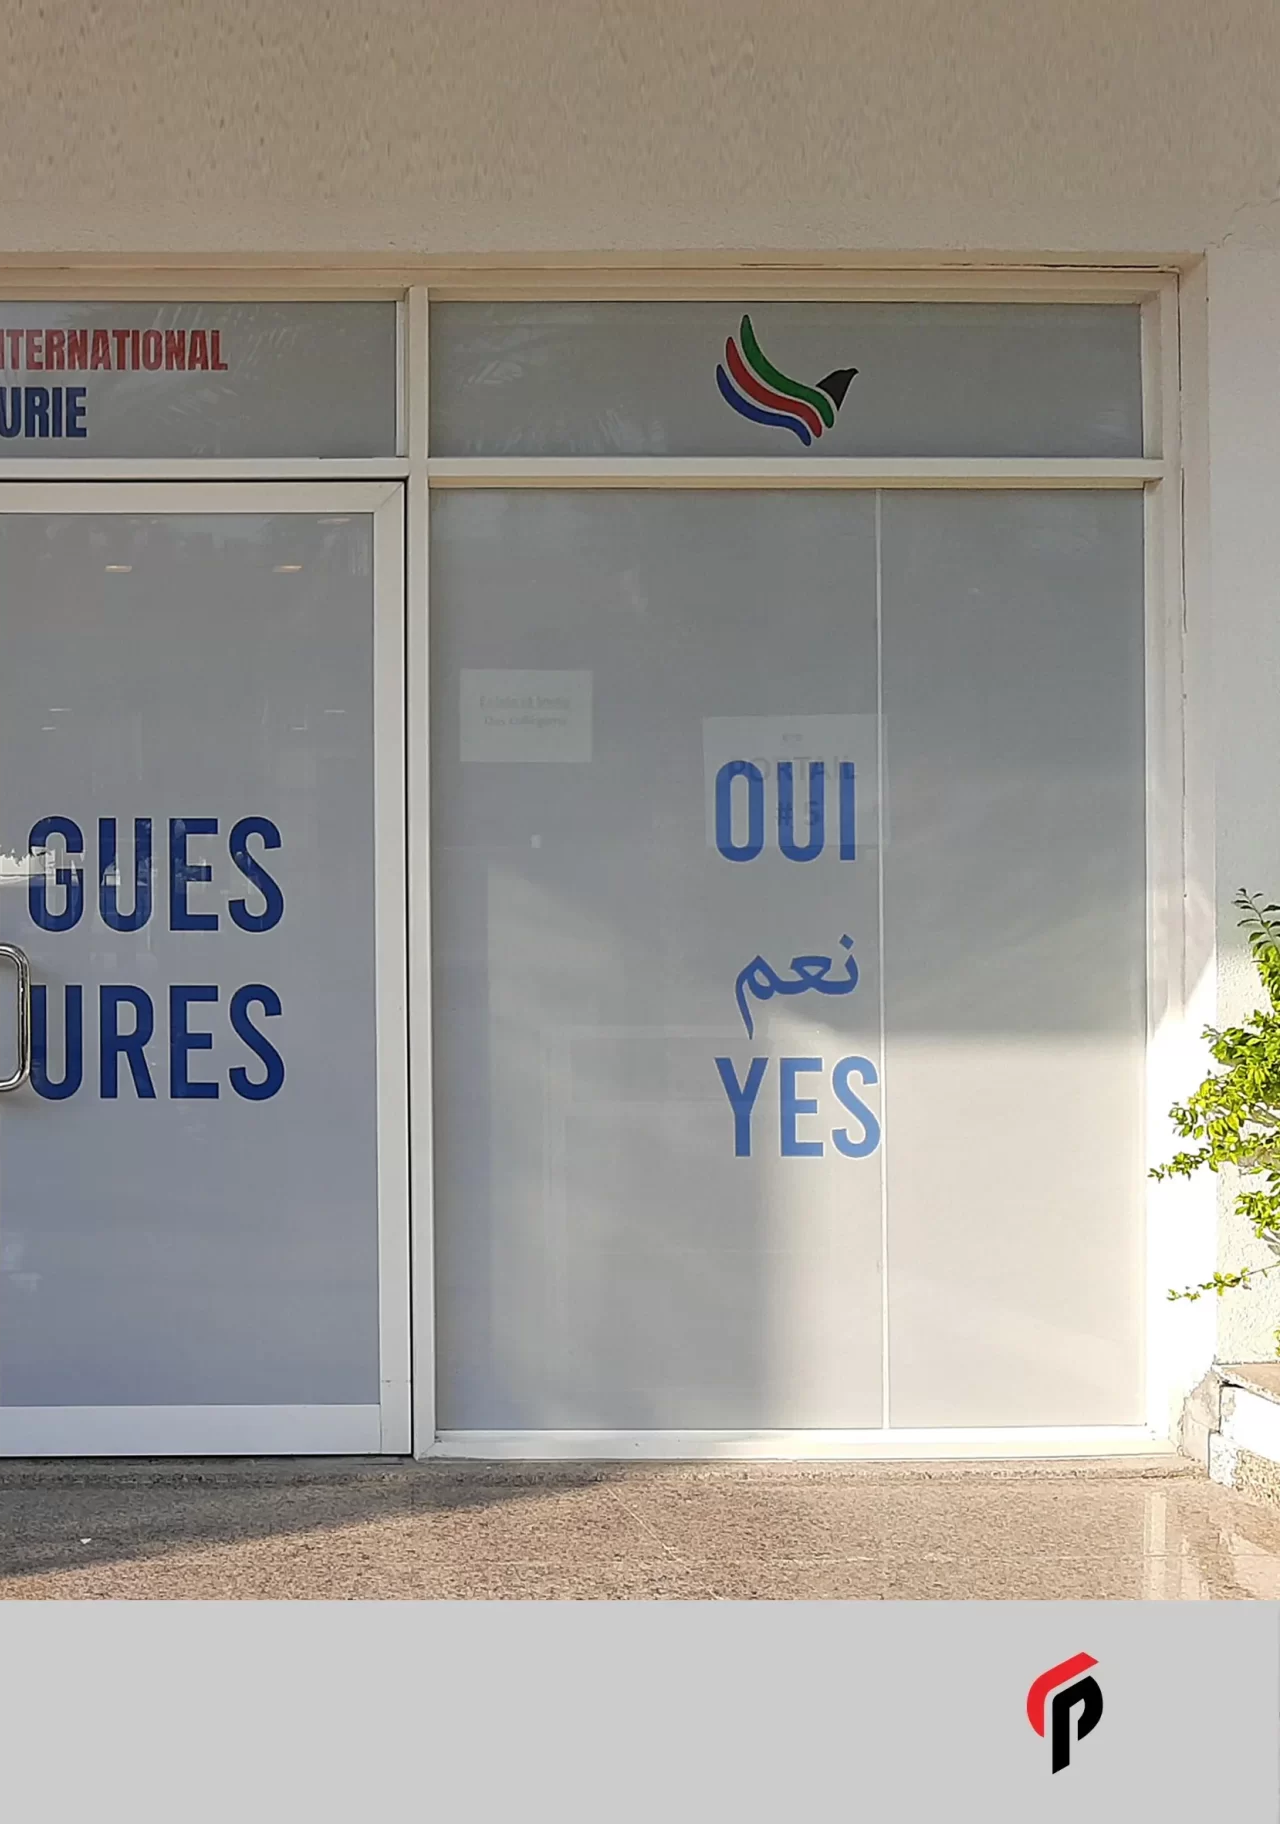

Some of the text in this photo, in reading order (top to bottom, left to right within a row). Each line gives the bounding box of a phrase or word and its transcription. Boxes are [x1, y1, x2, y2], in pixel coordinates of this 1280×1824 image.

[715, 760, 856, 862] OUI
[27, 816, 284, 932] GUES
[735, 934, 859, 1040] نعم
[29, 984, 285, 1101] URES
[714, 1056, 880, 1159] YES
